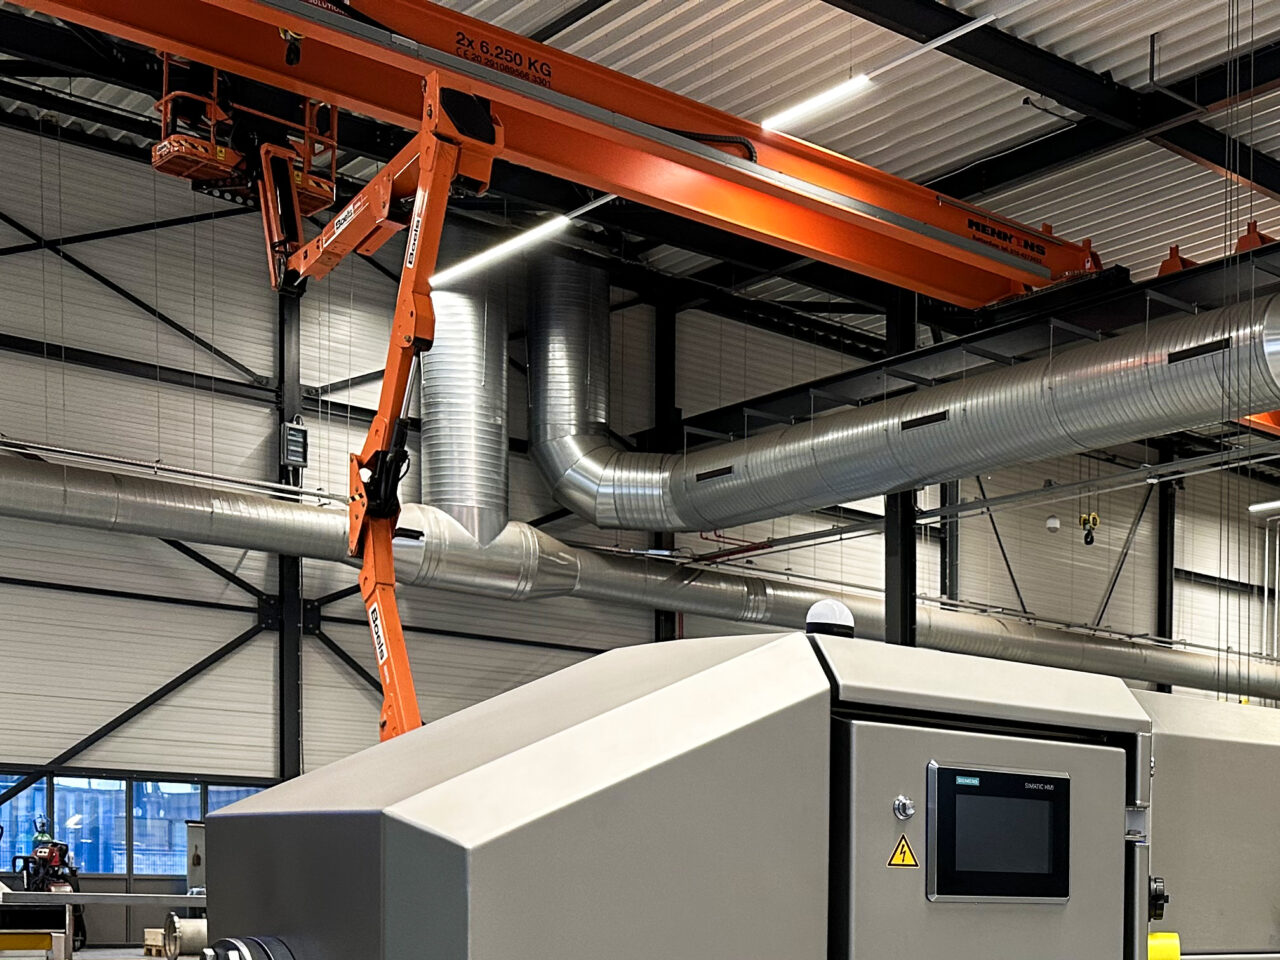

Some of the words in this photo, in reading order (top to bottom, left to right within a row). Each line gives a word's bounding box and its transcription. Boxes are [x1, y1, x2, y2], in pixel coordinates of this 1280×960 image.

[308, 0, 348, 15] OLUTIO
[456, 31, 475, 50] 2x
[479, 40, 523, 67] 6.250
[527, 57, 552, 78] KG
[370, 607, 385, 661] Boels
[1024, 782, 1044, 790] SIMATIC
